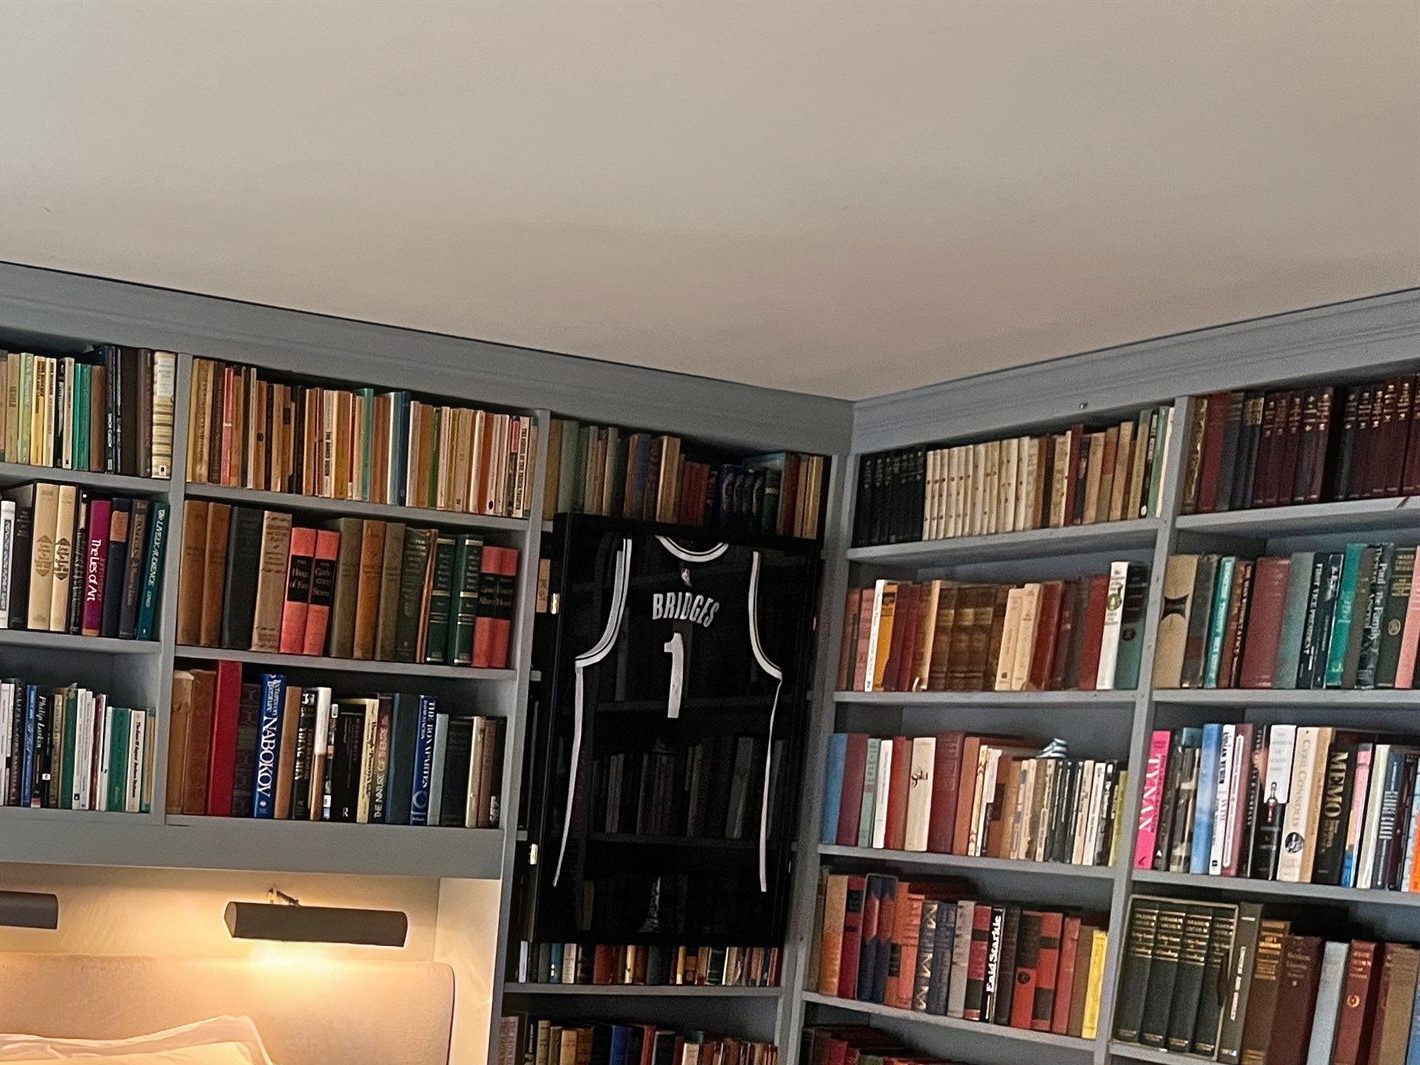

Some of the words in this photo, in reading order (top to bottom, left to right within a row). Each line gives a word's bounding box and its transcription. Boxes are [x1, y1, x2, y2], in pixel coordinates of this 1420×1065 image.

[91, 539, 102, 553] The
[153, 520, 164, 548] LIVELY
[89, 557, 100, 573] Lies
[148, 548, 160, 587] AUDIENCE
[1313, 563, 1323, 586] FIRST
[1376, 563, 1389, 585] Paul
[87, 585, 98, 602] Art
[88, 574, 99, 585] of
[653, 592, 720, 628] BRIDGES
[1310, 588, 1320, 609] VICE
[1375, 591, 1385, 606] The
[1304, 609, 1317, 655] PRESIDENT
[1370, 607, 1385, 640] Family
[663, 632, 684, 719] 1
[36, 696, 47, 721] Philip
[266, 680, 276, 712] Literature
[271, 706, 278, 716] on
[427, 701, 436, 721] THE
[36, 722, 45, 748] Larkin
[296, 727, 307, 757] YOUNG
[257, 716, 279, 798] NABOKOV
[421, 724, 434, 789] BONAPARTES
[1300, 739, 1312, 768] CYRIL
[295, 760, 304, 781] MEN
[1139, 754, 1162, 833] TYNAN
[1292, 770, 1307, 827] CONNOLLY
[1323, 752, 1349, 818] MEMO
[373, 804, 382, 818] THE
[987, 916, 1002, 962] Starkie
[986, 963, 996, 993] Enid
